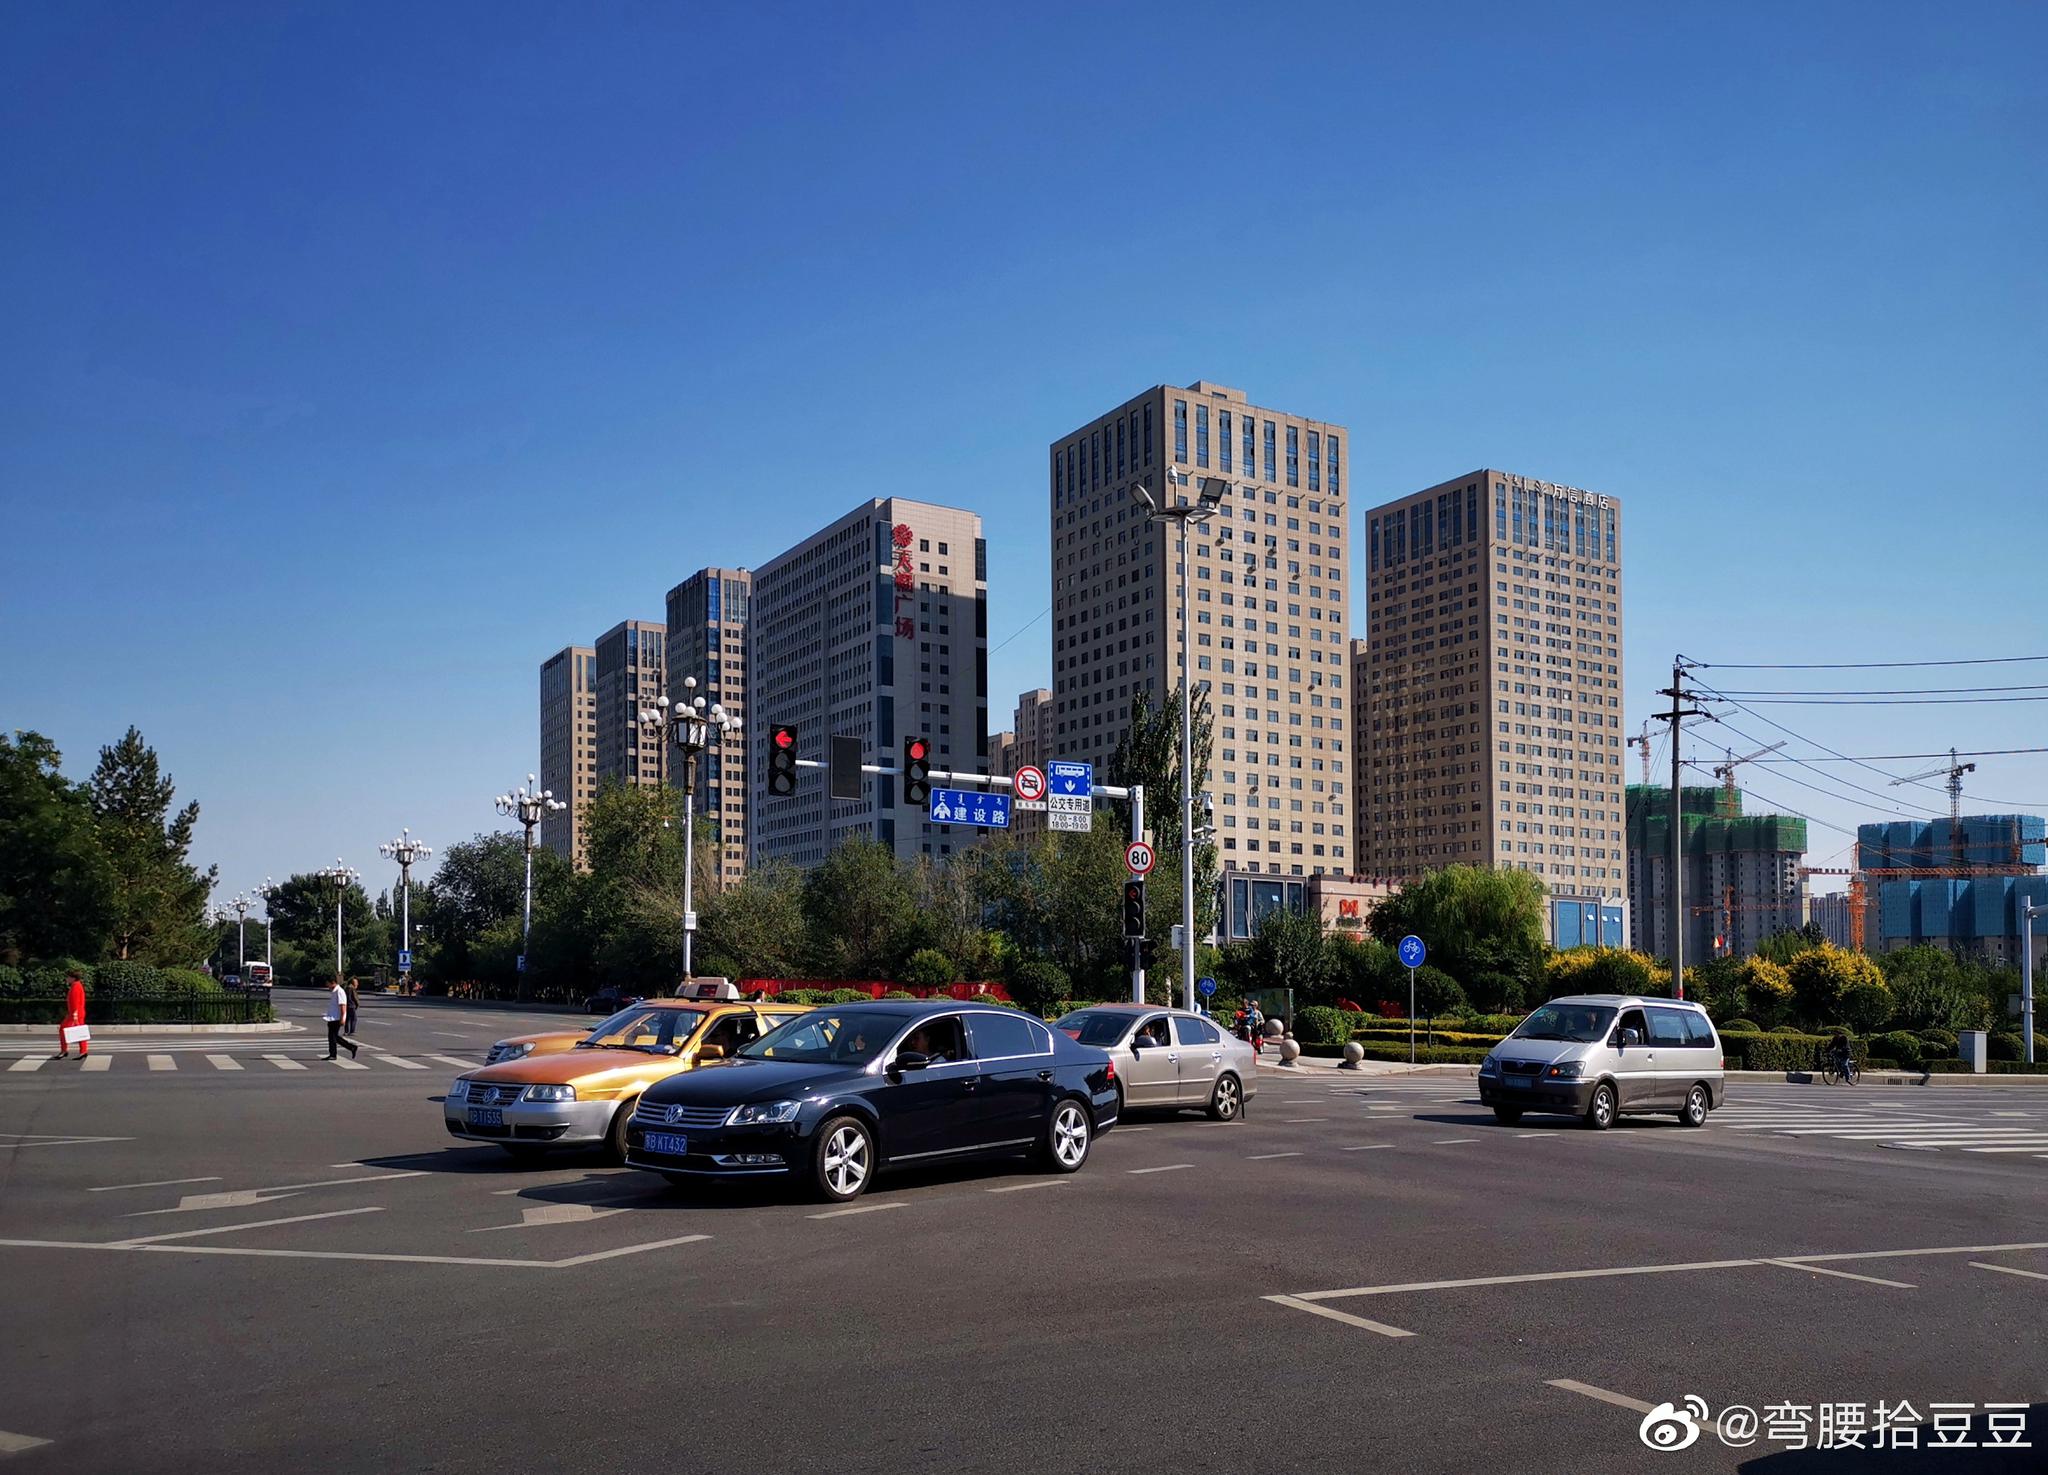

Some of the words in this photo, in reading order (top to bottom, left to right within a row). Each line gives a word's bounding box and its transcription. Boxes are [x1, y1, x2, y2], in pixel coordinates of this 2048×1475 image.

[939, 792, 946, 802] E
[1049, 797, 1091, 813] 公交专用道
[953, 807, 1006, 824] 建设路
[1131, 850, 1149, 866] 80
